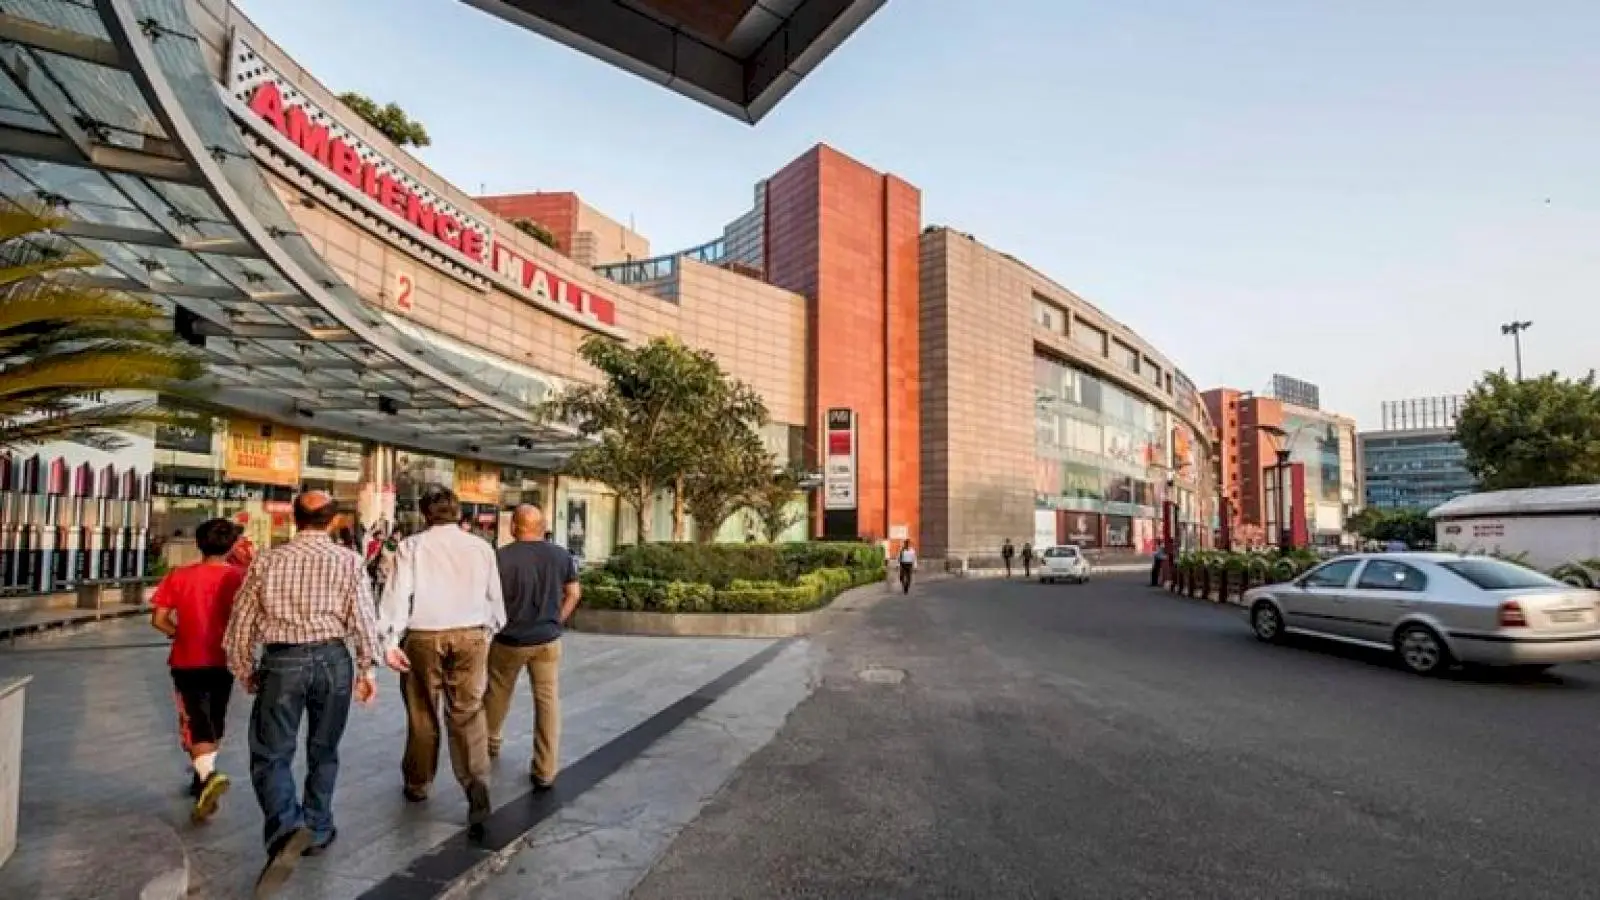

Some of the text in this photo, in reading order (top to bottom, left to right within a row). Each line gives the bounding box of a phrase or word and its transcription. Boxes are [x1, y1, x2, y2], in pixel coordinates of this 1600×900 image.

[249, 80, 601, 324] AMBIENCE MALL
[397, 274, 412, 310] 2
[155, 482, 185, 497] THE
[187, 484, 227, 498] BODY
